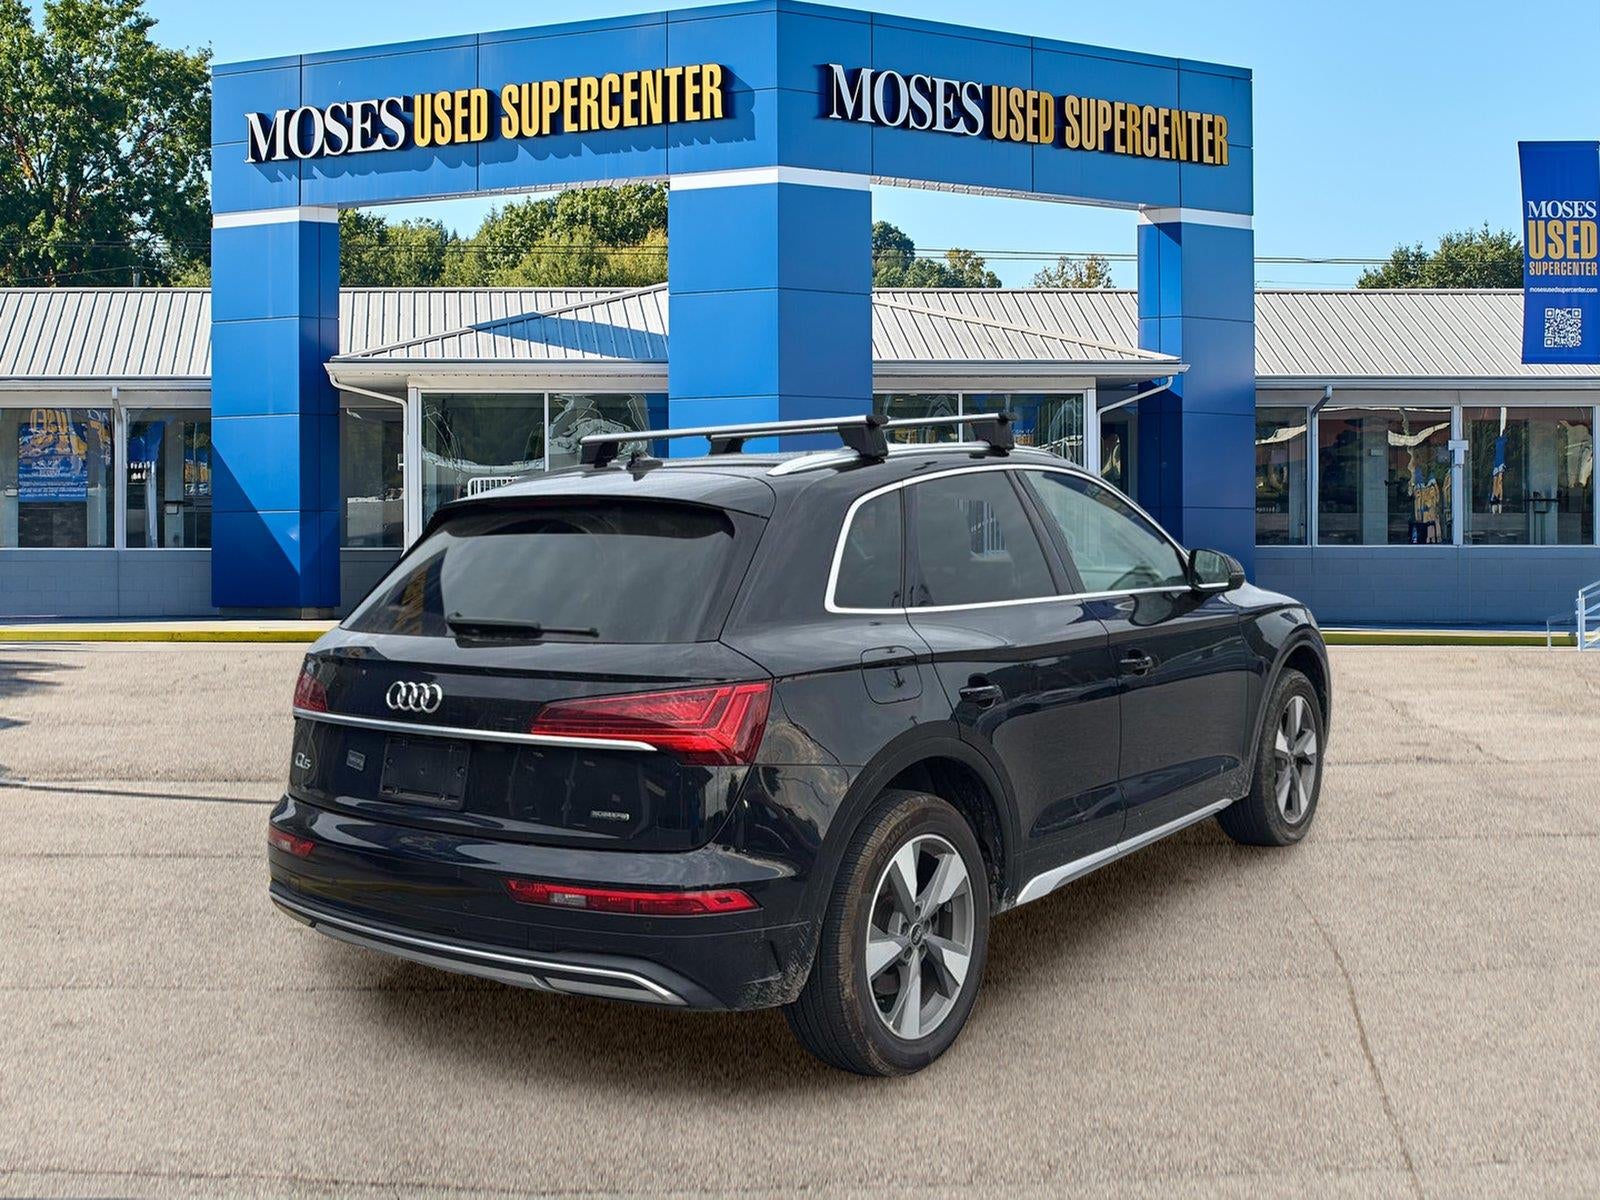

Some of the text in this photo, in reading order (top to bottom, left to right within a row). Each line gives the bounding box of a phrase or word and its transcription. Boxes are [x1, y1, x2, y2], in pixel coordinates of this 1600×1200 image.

[244, 62, 724, 164] MOSES USED SUPERCENTER
[828, 62, 1230, 166] MOSES USED SUPERCENTER
[1526, 200, 1598, 219] MOSES
[1527, 219, 1599, 260] USED
[1528, 260, 1599, 276] SUPERCENTER
